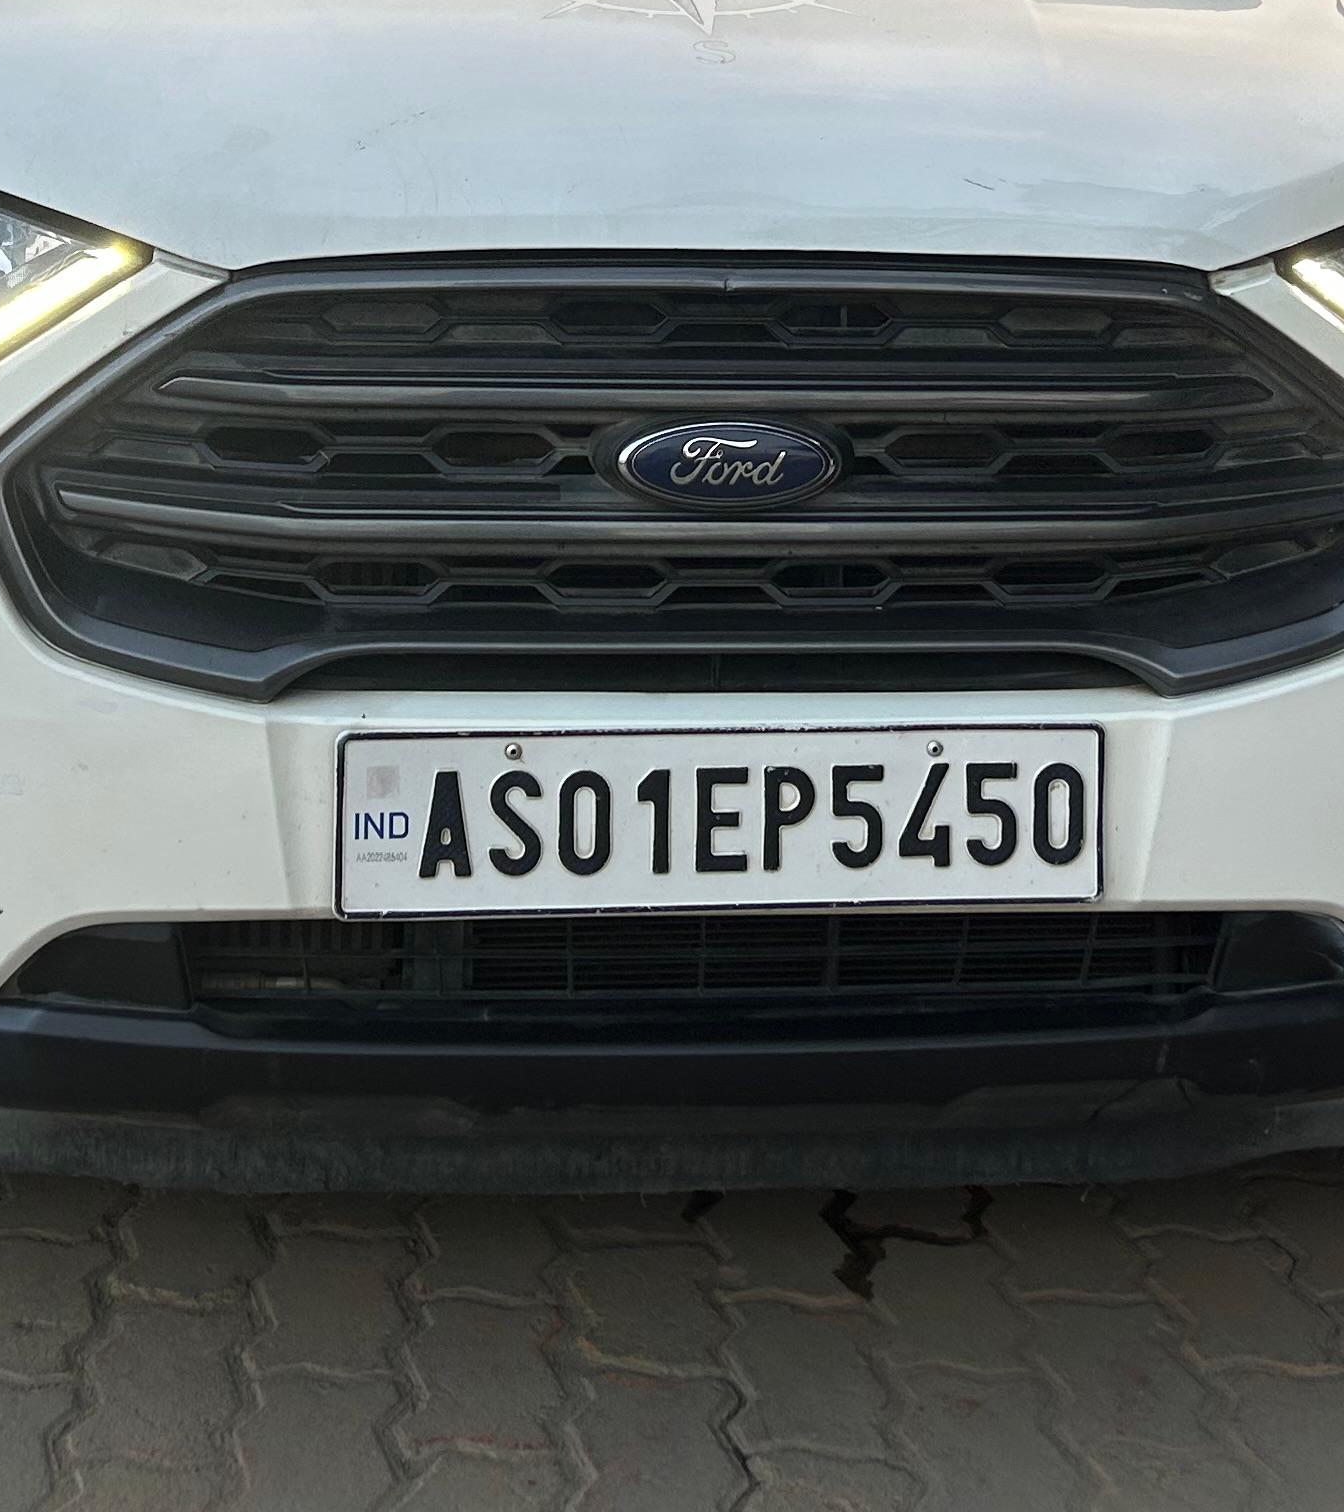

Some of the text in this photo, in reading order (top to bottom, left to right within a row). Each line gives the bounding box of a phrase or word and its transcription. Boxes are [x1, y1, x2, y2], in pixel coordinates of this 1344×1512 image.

[692, 39, 736, 65] S
[670, 437, 787, 485] Ford
[354, 811, 409, 840] IND
[418, 761, 1084, 879] AS01EP5450
